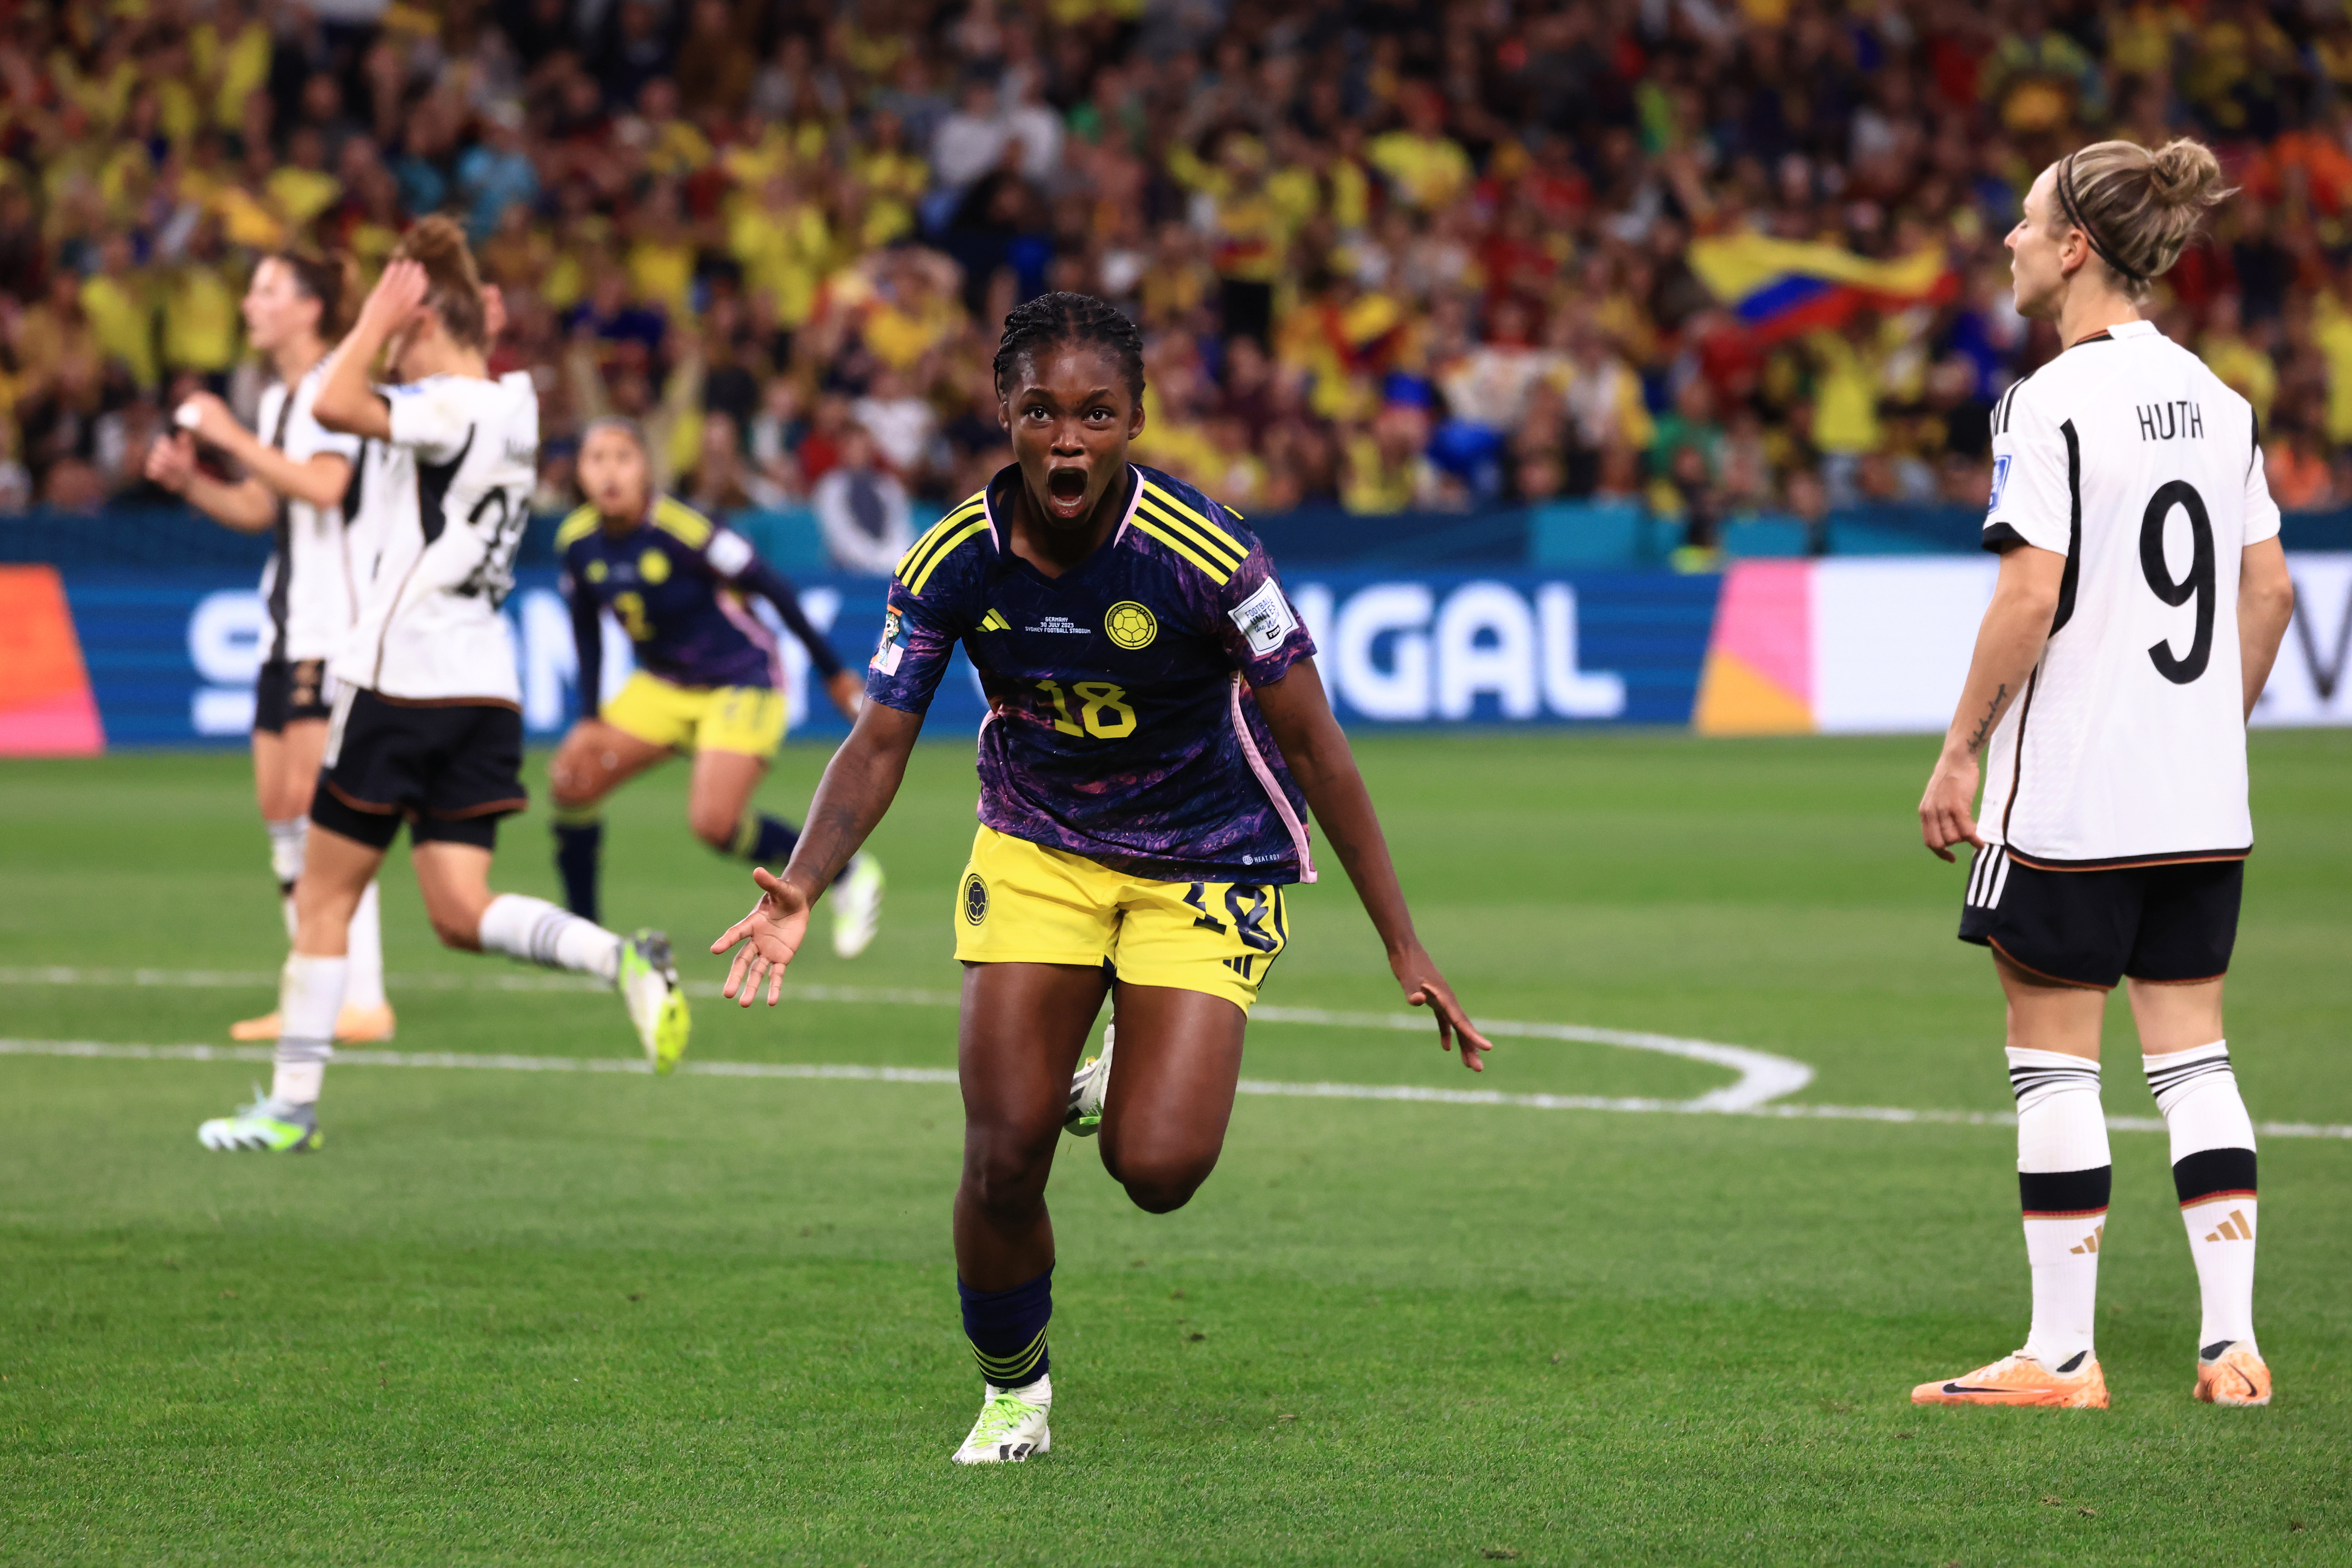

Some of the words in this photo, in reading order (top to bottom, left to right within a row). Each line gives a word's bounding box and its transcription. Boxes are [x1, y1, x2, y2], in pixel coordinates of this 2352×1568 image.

[2136, 400, 2204, 441] HUTH
[2140, 479, 2216, 684] 9
[1245, 595, 1272, 619] FOOTBALL
[1250, 601, 1276, 625] UNITES
[1035, 680, 1137, 739] 18
[1254, 854, 1280, 863] HEAT.RDY
